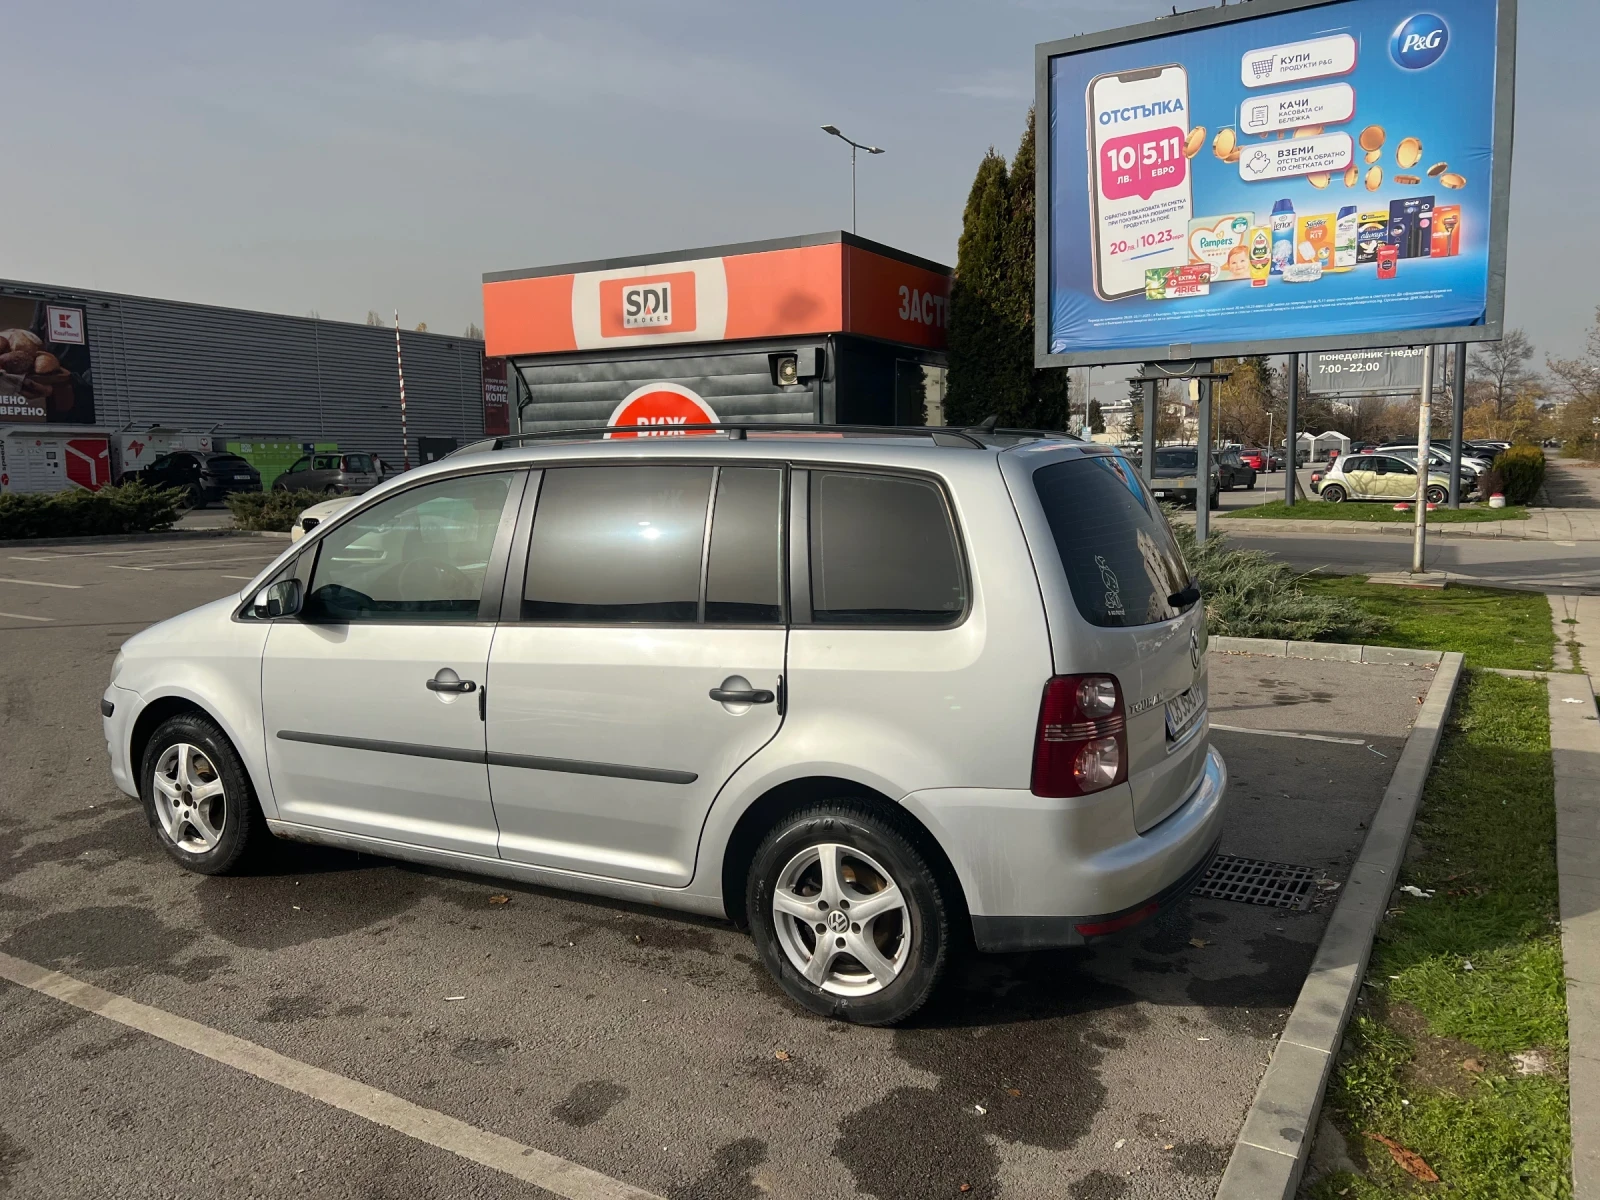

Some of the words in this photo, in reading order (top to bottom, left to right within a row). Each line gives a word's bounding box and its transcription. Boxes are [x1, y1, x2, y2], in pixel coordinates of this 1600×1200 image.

[1402, 30, 1442, 53] P&G
[1280, 53, 1310, 65] КУПИ
[1280, 60, 1317, 72] ПРОДУКТИ
[1279, 98, 1309, 110] КАЧИ
[1099, 98, 1184, 125] ОТСТЪПКА
[1278, 106, 1312, 117] КАСОВАТА
[1278, 115, 1310, 124] БЕЛЕЖКА
[1107, 146, 1136, 172] 10
[1142, 137, 1180, 165] 5,11
[1277, 145, 1314, 158] ВЗЕМИ
[1277, 155, 1312, 165] ОТСТЪПКА
[1313, 151, 1346, 160] ОБРАТНО
[1288, 162, 1323, 171] СМЕТКАТА
[1117, 175, 1132, 184] ЛВ.
[1151, 166, 1175, 177] ЕВРО
[1104, 211, 1127, 221] ОБРАТНО
[1168, 198, 1186, 207] СМЕТКА
[1118, 215, 1142, 224] ПОКУПКА
[1123, 219, 1149, 229] ПРОДУКТИ
[1156, 214, 1170, 222] ПОНЕ
[1273, 221, 1292, 231] Lenor
[1200, 237, 1233, 248] Pampers
[1174, 285, 1201, 294] ARIEL
[626, 288, 668, 316] SDI
[626, 316, 668, 324] BROKER
[1319, 350, 1383, 361] понеделник
[1391, 348, 1424, 358] недел
[0, 395, 29, 405] ЕНО.
